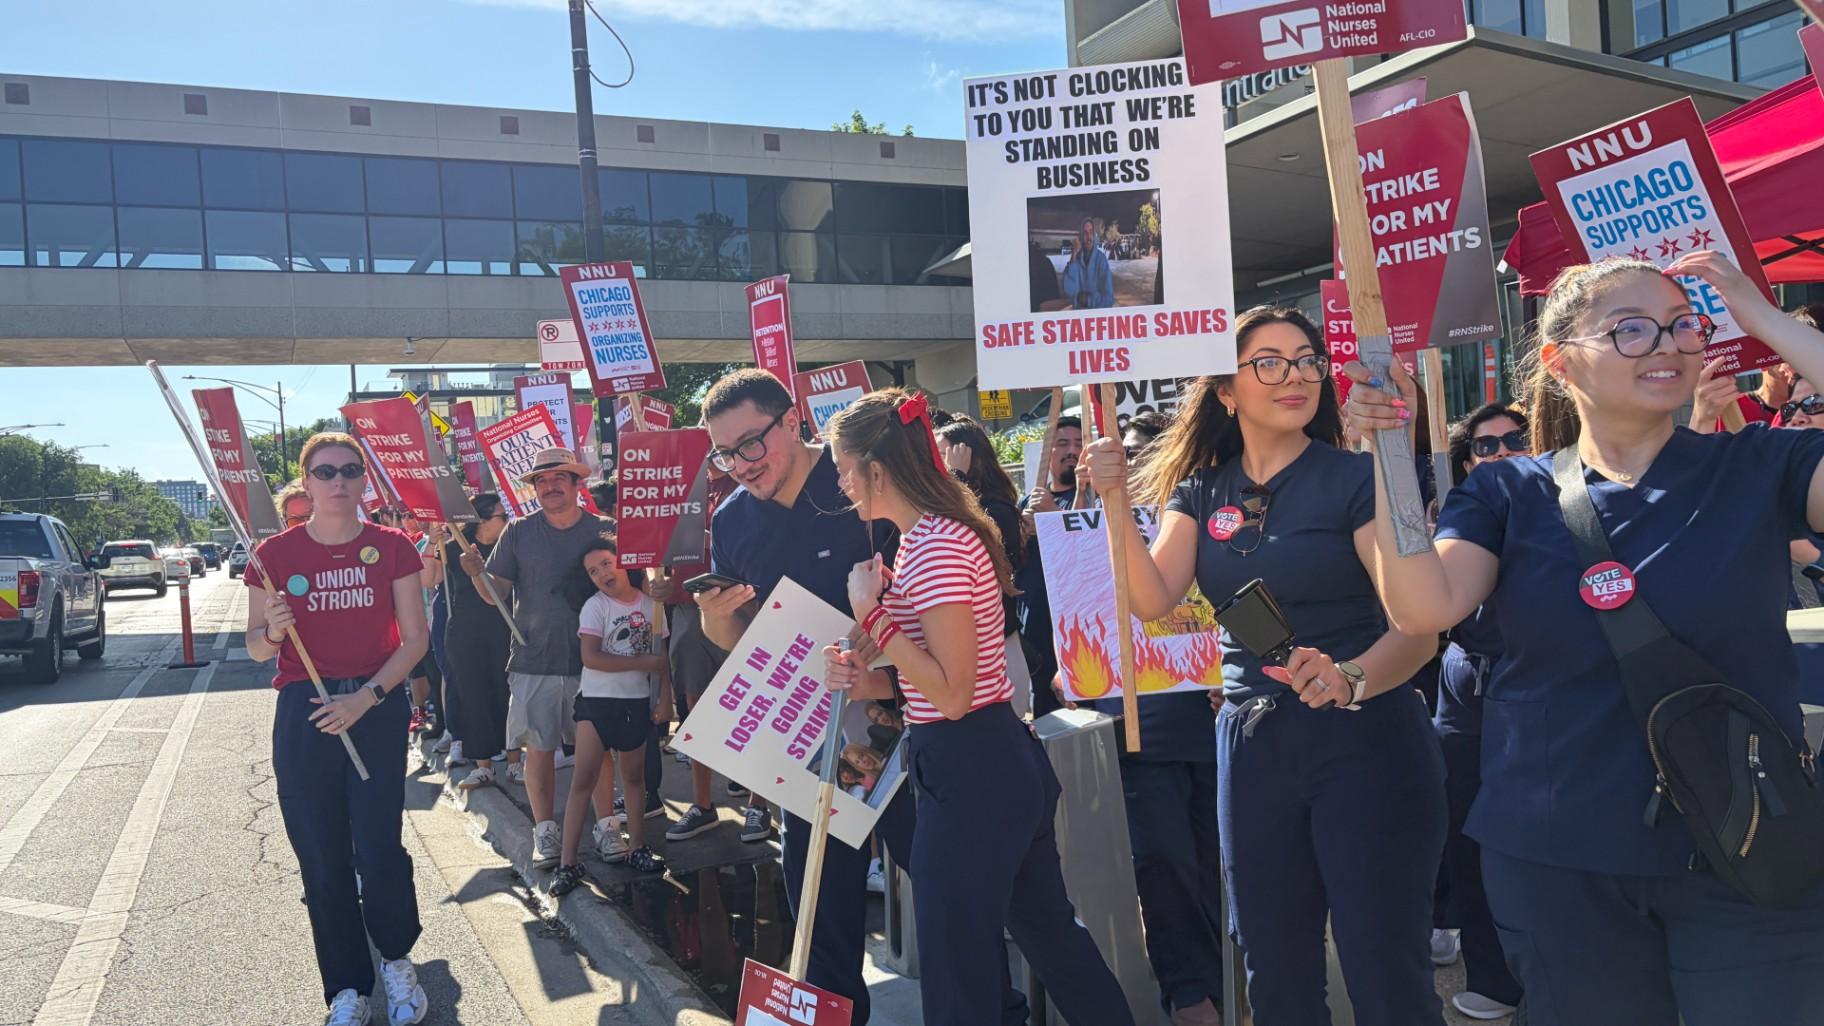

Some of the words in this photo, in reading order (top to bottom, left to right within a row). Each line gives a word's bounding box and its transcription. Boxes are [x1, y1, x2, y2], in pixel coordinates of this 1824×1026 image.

[1325, 0, 1386, 17] National
[1327, 19, 1377, 33] Nurses
[1330, 32, 1378, 48] United
[1400, 29, 1437, 42] AFL-CIO
[968, 81, 1008, 107] IT'S
[1014, 75, 1057, 102] NOT
[1069, 62, 1183, 97] CLOCKING
[974, 113, 1001, 137] TO
[1007, 106, 1052, 133] YOU
[1060, 102, 1115, 129] THAT
[1126, 94, 1196, 122] WE'RE
[1005, 130, 1118, 163] STANDING
[1129, 127, 1159, 152] ON
[1566, 120, 1653, 171] NNU
[1037, 158, 1150, 190] BUSINESS
[1364, 168, 1440, 204] TRIKE
[1571, 160, 1694, 221] CHICAGO
[1370, 210, 1407, 235] OR
[1413, 198, 1451, 227] MY
[1586, 195, 1706, 249] SUPPORTS
[1376, 227, 1482, 268] ATIENTS
[578, 265, 616, 279] NNU
[578, 286, 631, 304] CHICAGO
[754, 280, 775, 298] NNU
[583, 303, 635, 319] SUPPORTS
[983, 321, 1035, 349] SAFE
[1042, 314, 1147, 344] STAFFING
[1154, 308, 1227, 336] SAVES
[1449, 324, 1494, 337] #RNStrike
[591, 332, 643, 347] ORGANIZING
[594, 345, 648, 365] NURSES
[1069, 347, 1130, 374] LIVES
[528, 374, 557, 386] NNU
[809, 368, 848, 392] NNU
[356, 418, 377, 429] ON
[483, 420, 513, 437] National
[513, 408, 540, 424] Nurses
[367, 433, 413, 447] STRIKE
[501, 430, 535, 453] OUR
[376, 451, 403, 463] FOR
[403, 449, 425, 462] MY
[623, 449, 650, 462] ON
[387, 465, 450, 479] PATIENTS
[622, 466, 683, 481] STRIKE
[622, 486, 659, 500] FOR
[663, 484, 687, 498] MY
[622, 502, 702, 518] PATIENTS
[1216, 512, 1238, 521] VOTE
[316, 566, 366, 589] UNION
[1584, 568, 1621, 585] VOTE
[1596, 580, 1626, 593] YES
[307, 586, 374, 612] STRONG
[719, 673, 752, 711] GET
[746, 646, 772, 672] IN
[724, 694, 777, 753] LOSER,
[766, 633, 815, 690] WE'RE
[771, 675, 819, 734] GOING
